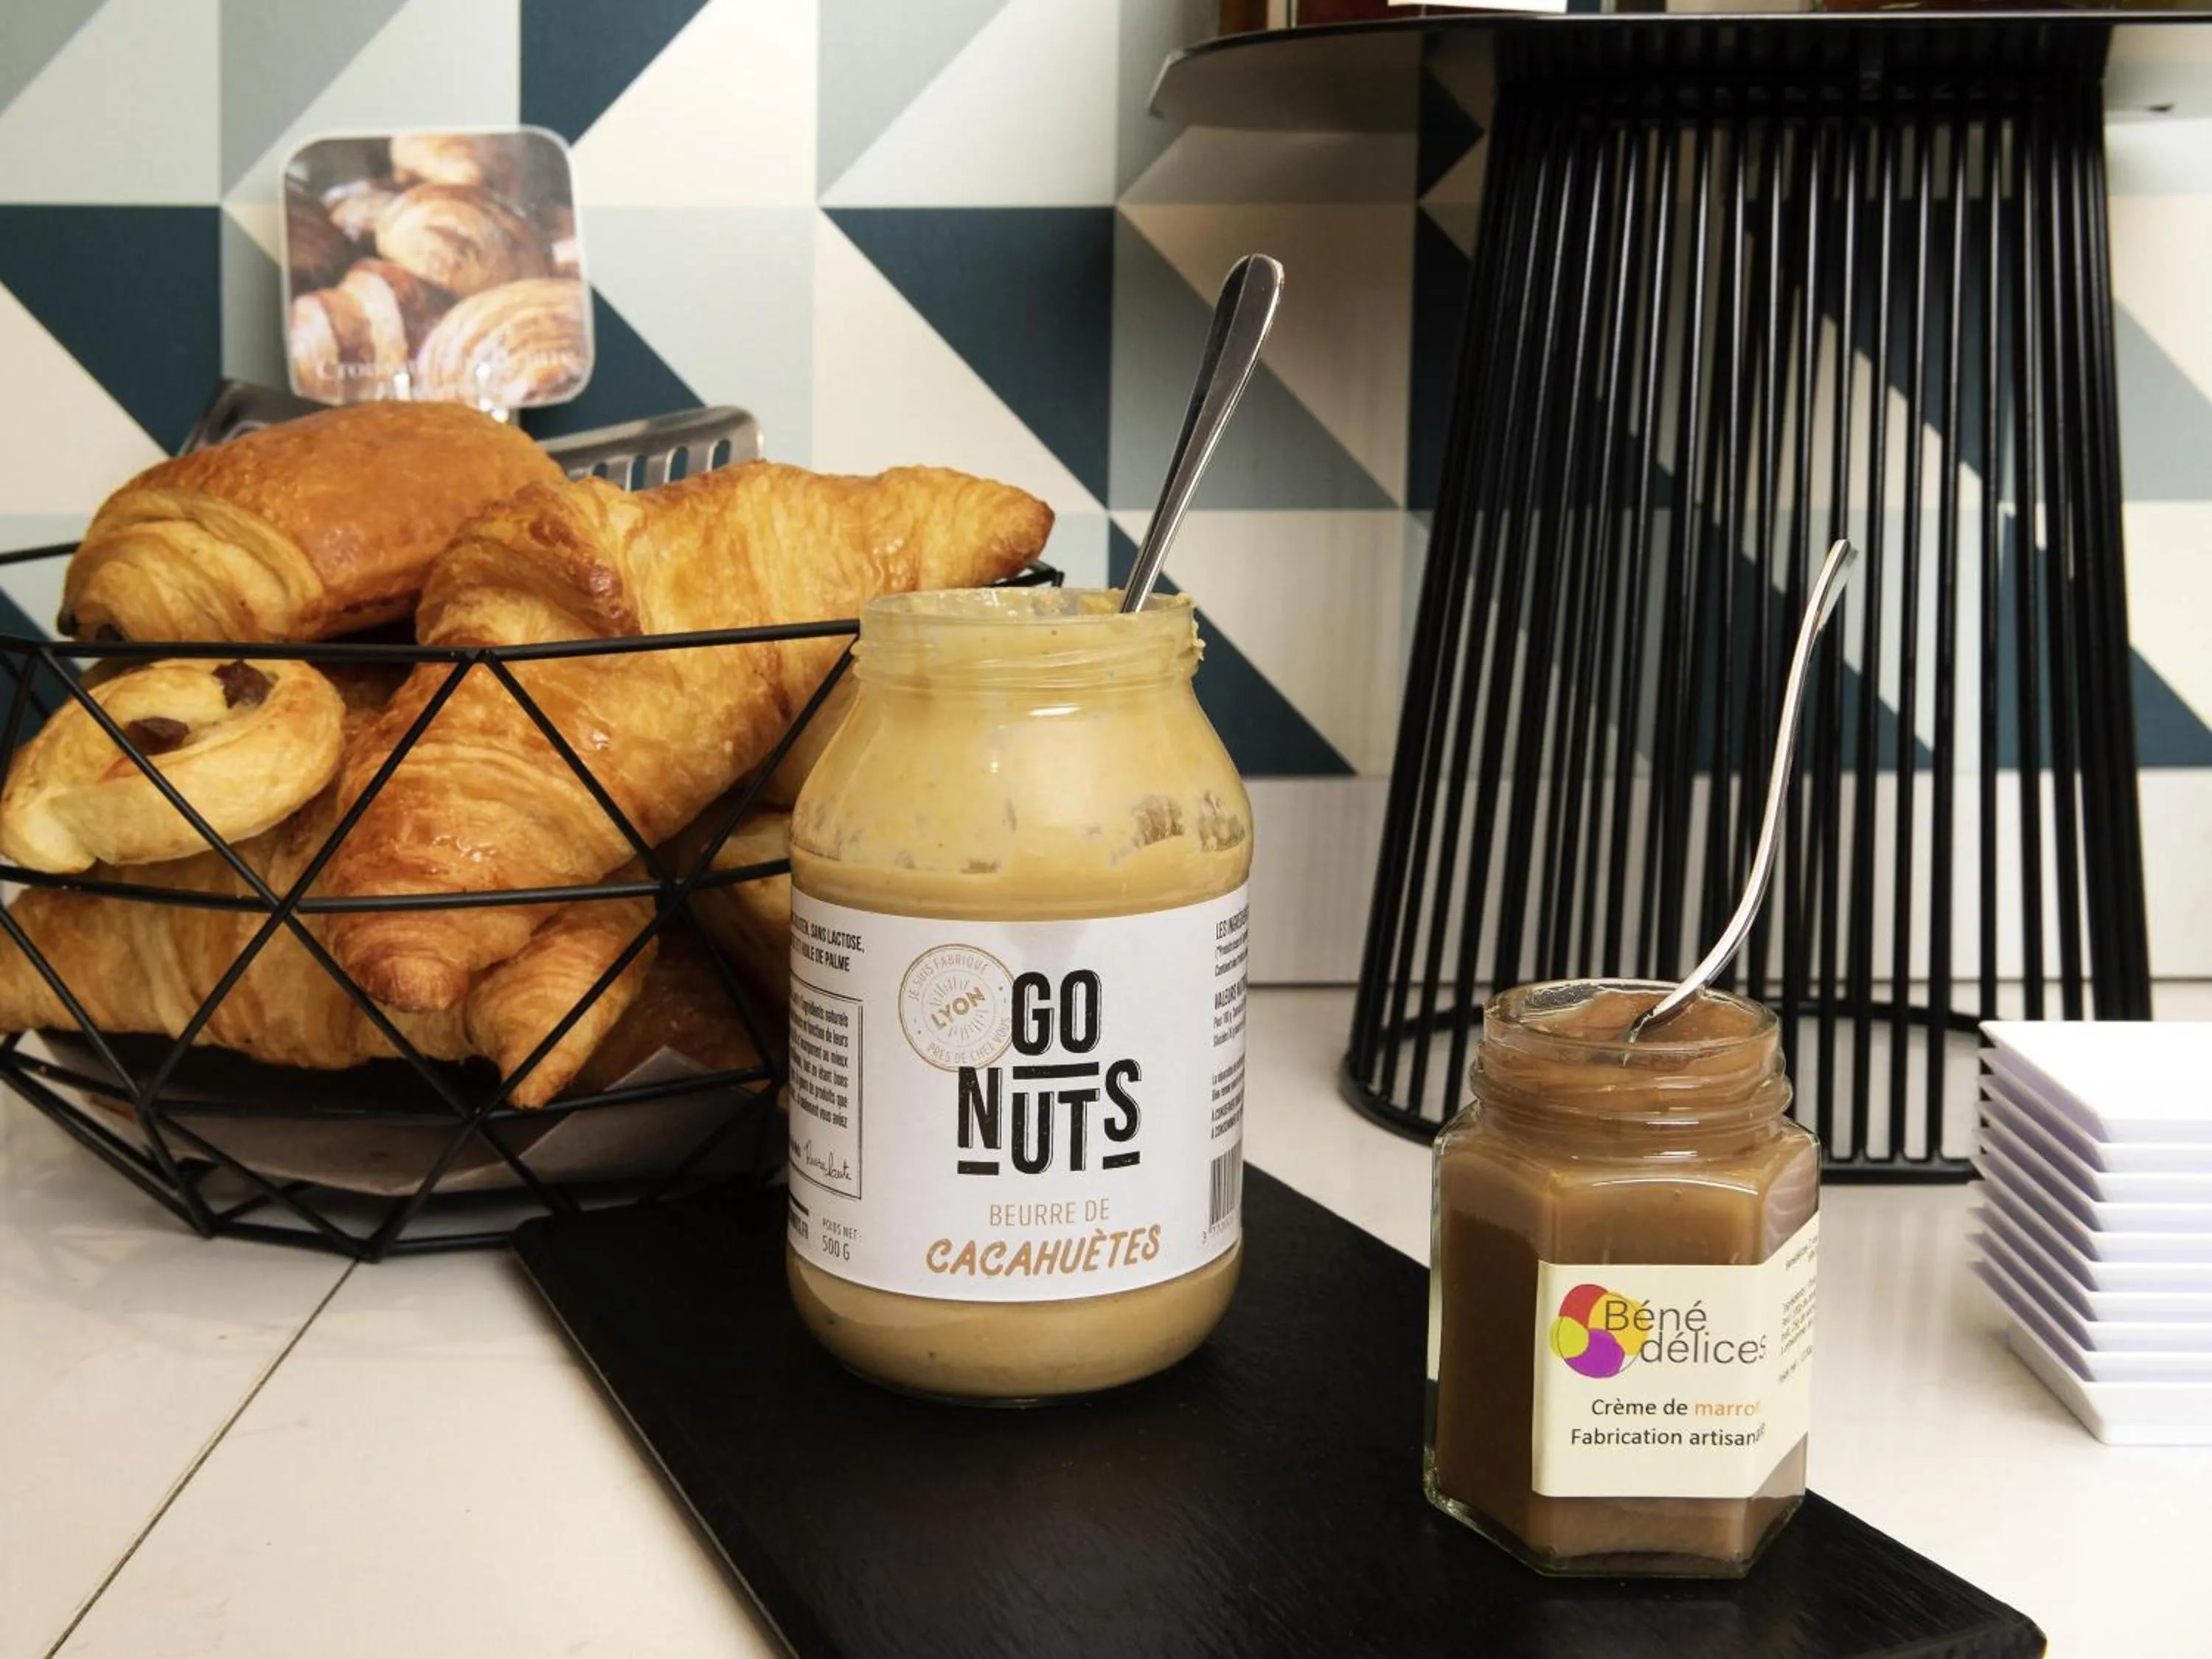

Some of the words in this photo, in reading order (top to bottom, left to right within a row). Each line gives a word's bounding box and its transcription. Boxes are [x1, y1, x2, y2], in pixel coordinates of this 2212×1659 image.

[827, 929, 865, 953] LACTOSE,
[1216, 920, 1226, 940] LES
[825, 950, 850, 973] PALME
[931, 986, 985, 1031] LYON
[1011, 969, 1102, 1056] GO
[958, 1059, 1141, 1174] NUTS
[990, 1201, 1076, 1226] BEURRE
[1085, 1198, 1110, 1222] DE
[822, 1235, 841, 1258] 500
[842, 1242, 851, 1262] G
[926, 1224, 1162, 1277] CACAHUÈTES
[1604, 1299, 1708, 1332] Béné
[1641, 1331, 1767, 1364] délices
[1591, 1398, 1656, 1416] Crème
[1663, 1399, 1688, 1416] de
[1694, 1401, 1760, 1416] marro
[1571, 1428, 1682, 1446] Fabrication
[1688, 1422, 1765, 1446] artisan
